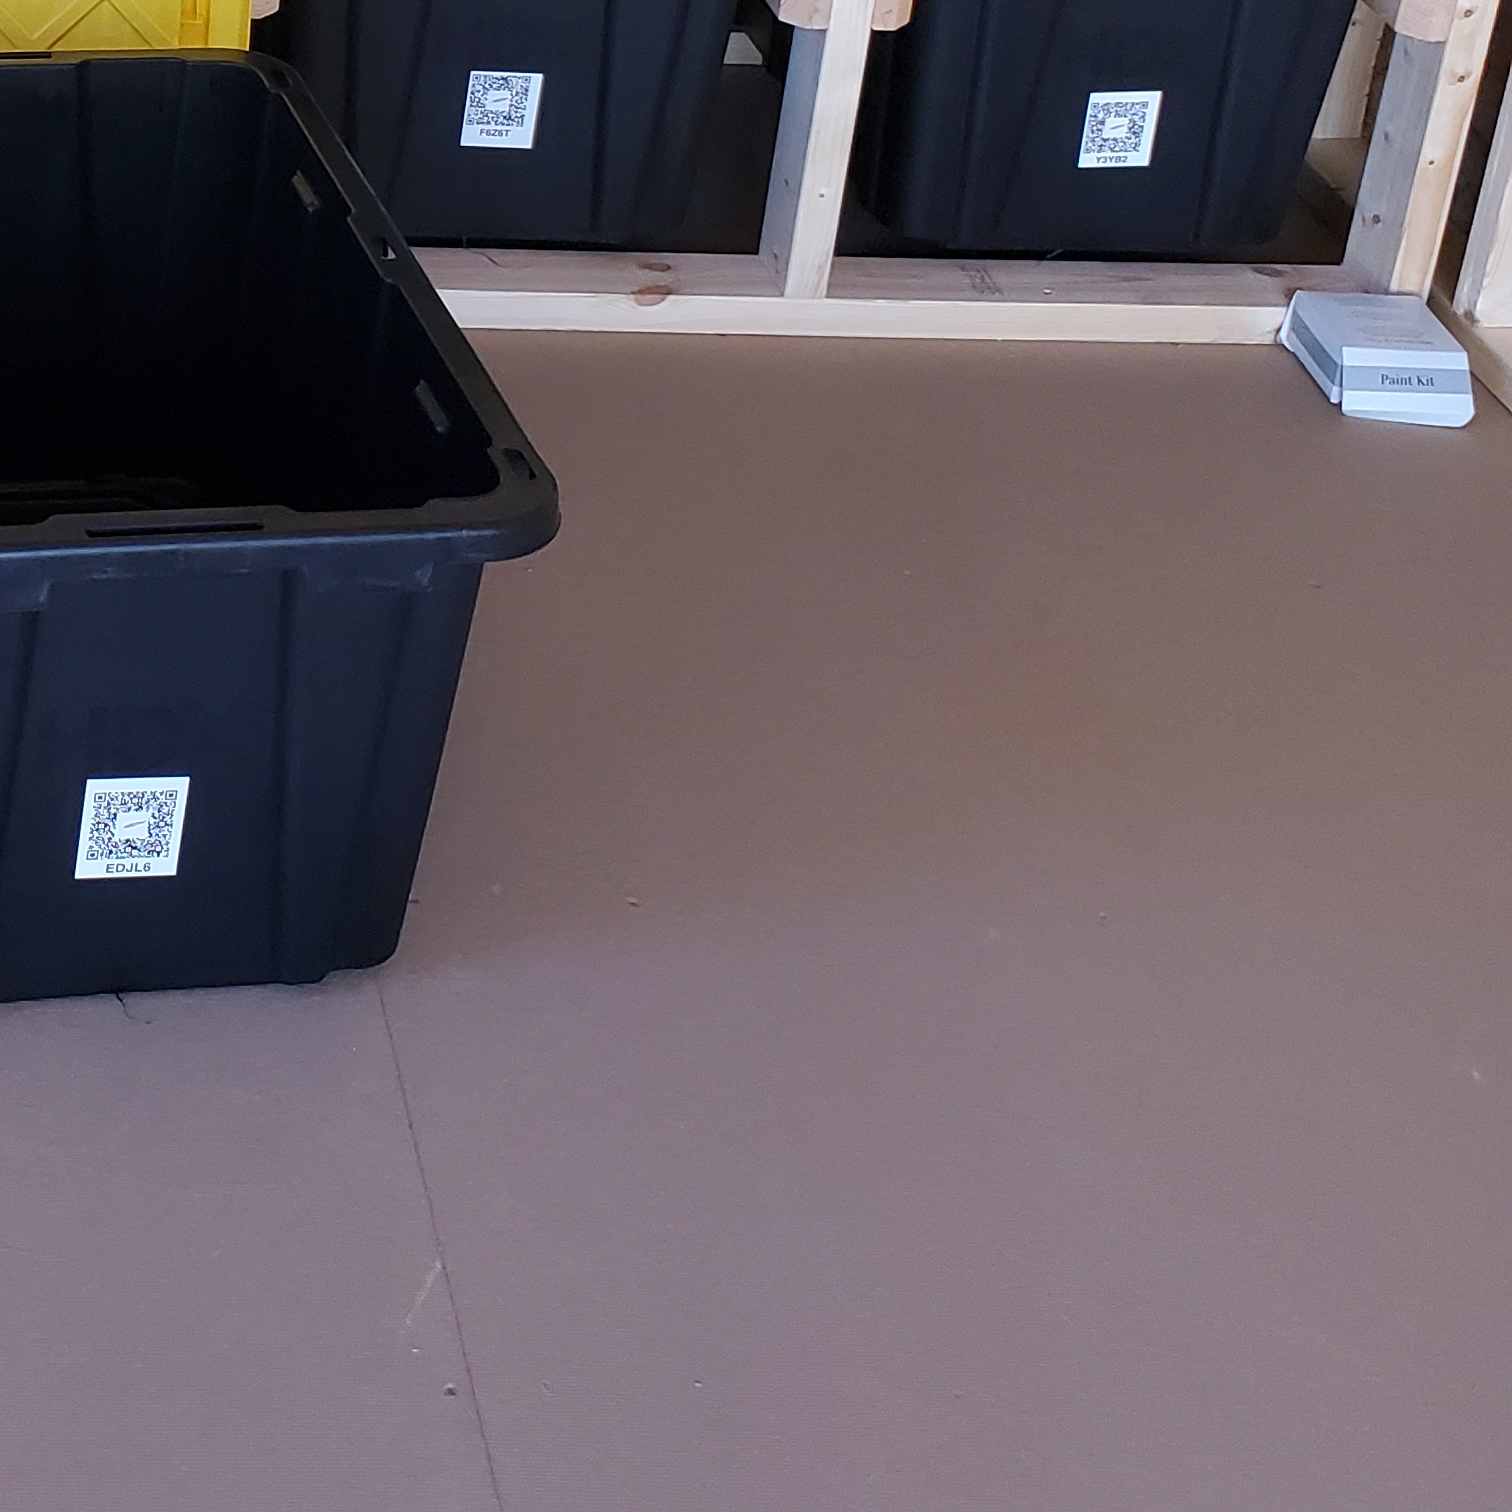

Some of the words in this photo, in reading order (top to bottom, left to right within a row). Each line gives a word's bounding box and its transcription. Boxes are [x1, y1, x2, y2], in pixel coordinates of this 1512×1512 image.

[479, 129, 511, 137] F6Z6T
[1380, 373, 1413, 388] Paint
[1416, 374, 1435, 387] Kit
[105, 863, 151, 873] EDJL6
